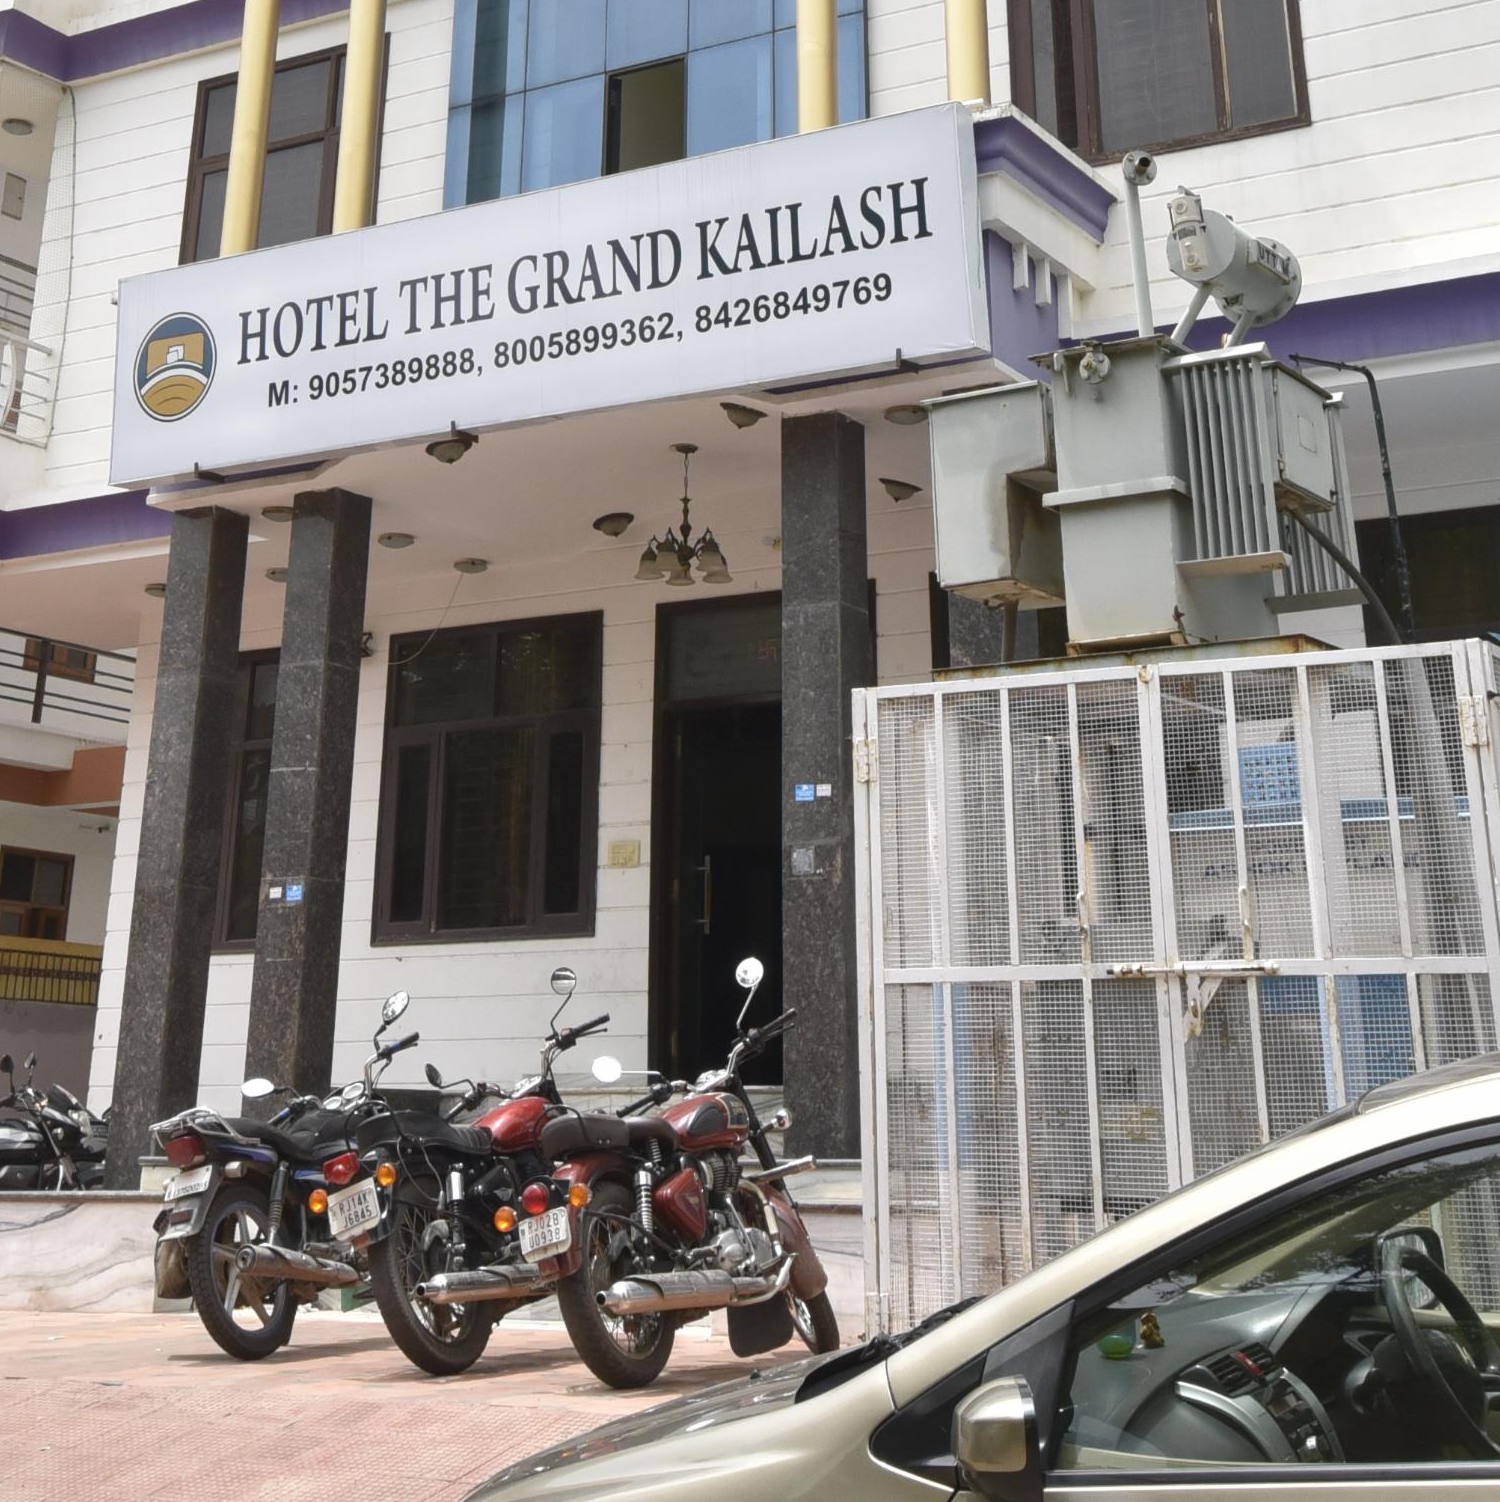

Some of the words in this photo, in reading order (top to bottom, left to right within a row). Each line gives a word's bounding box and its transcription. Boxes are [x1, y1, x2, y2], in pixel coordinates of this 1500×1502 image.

[238, 287, 388, 364] HOTEL
[400, 264, 495, 334] THE
[508, 229, 681, 313] GRAND
[695, 177, 932, 280] KAILASH
[269, 380, 297, 407] M:
[309, 348, 482, 400] 9057389888,
[494, 313, 682, 368] 8005899362,
[696, 273, 891, 332] 8426849769
